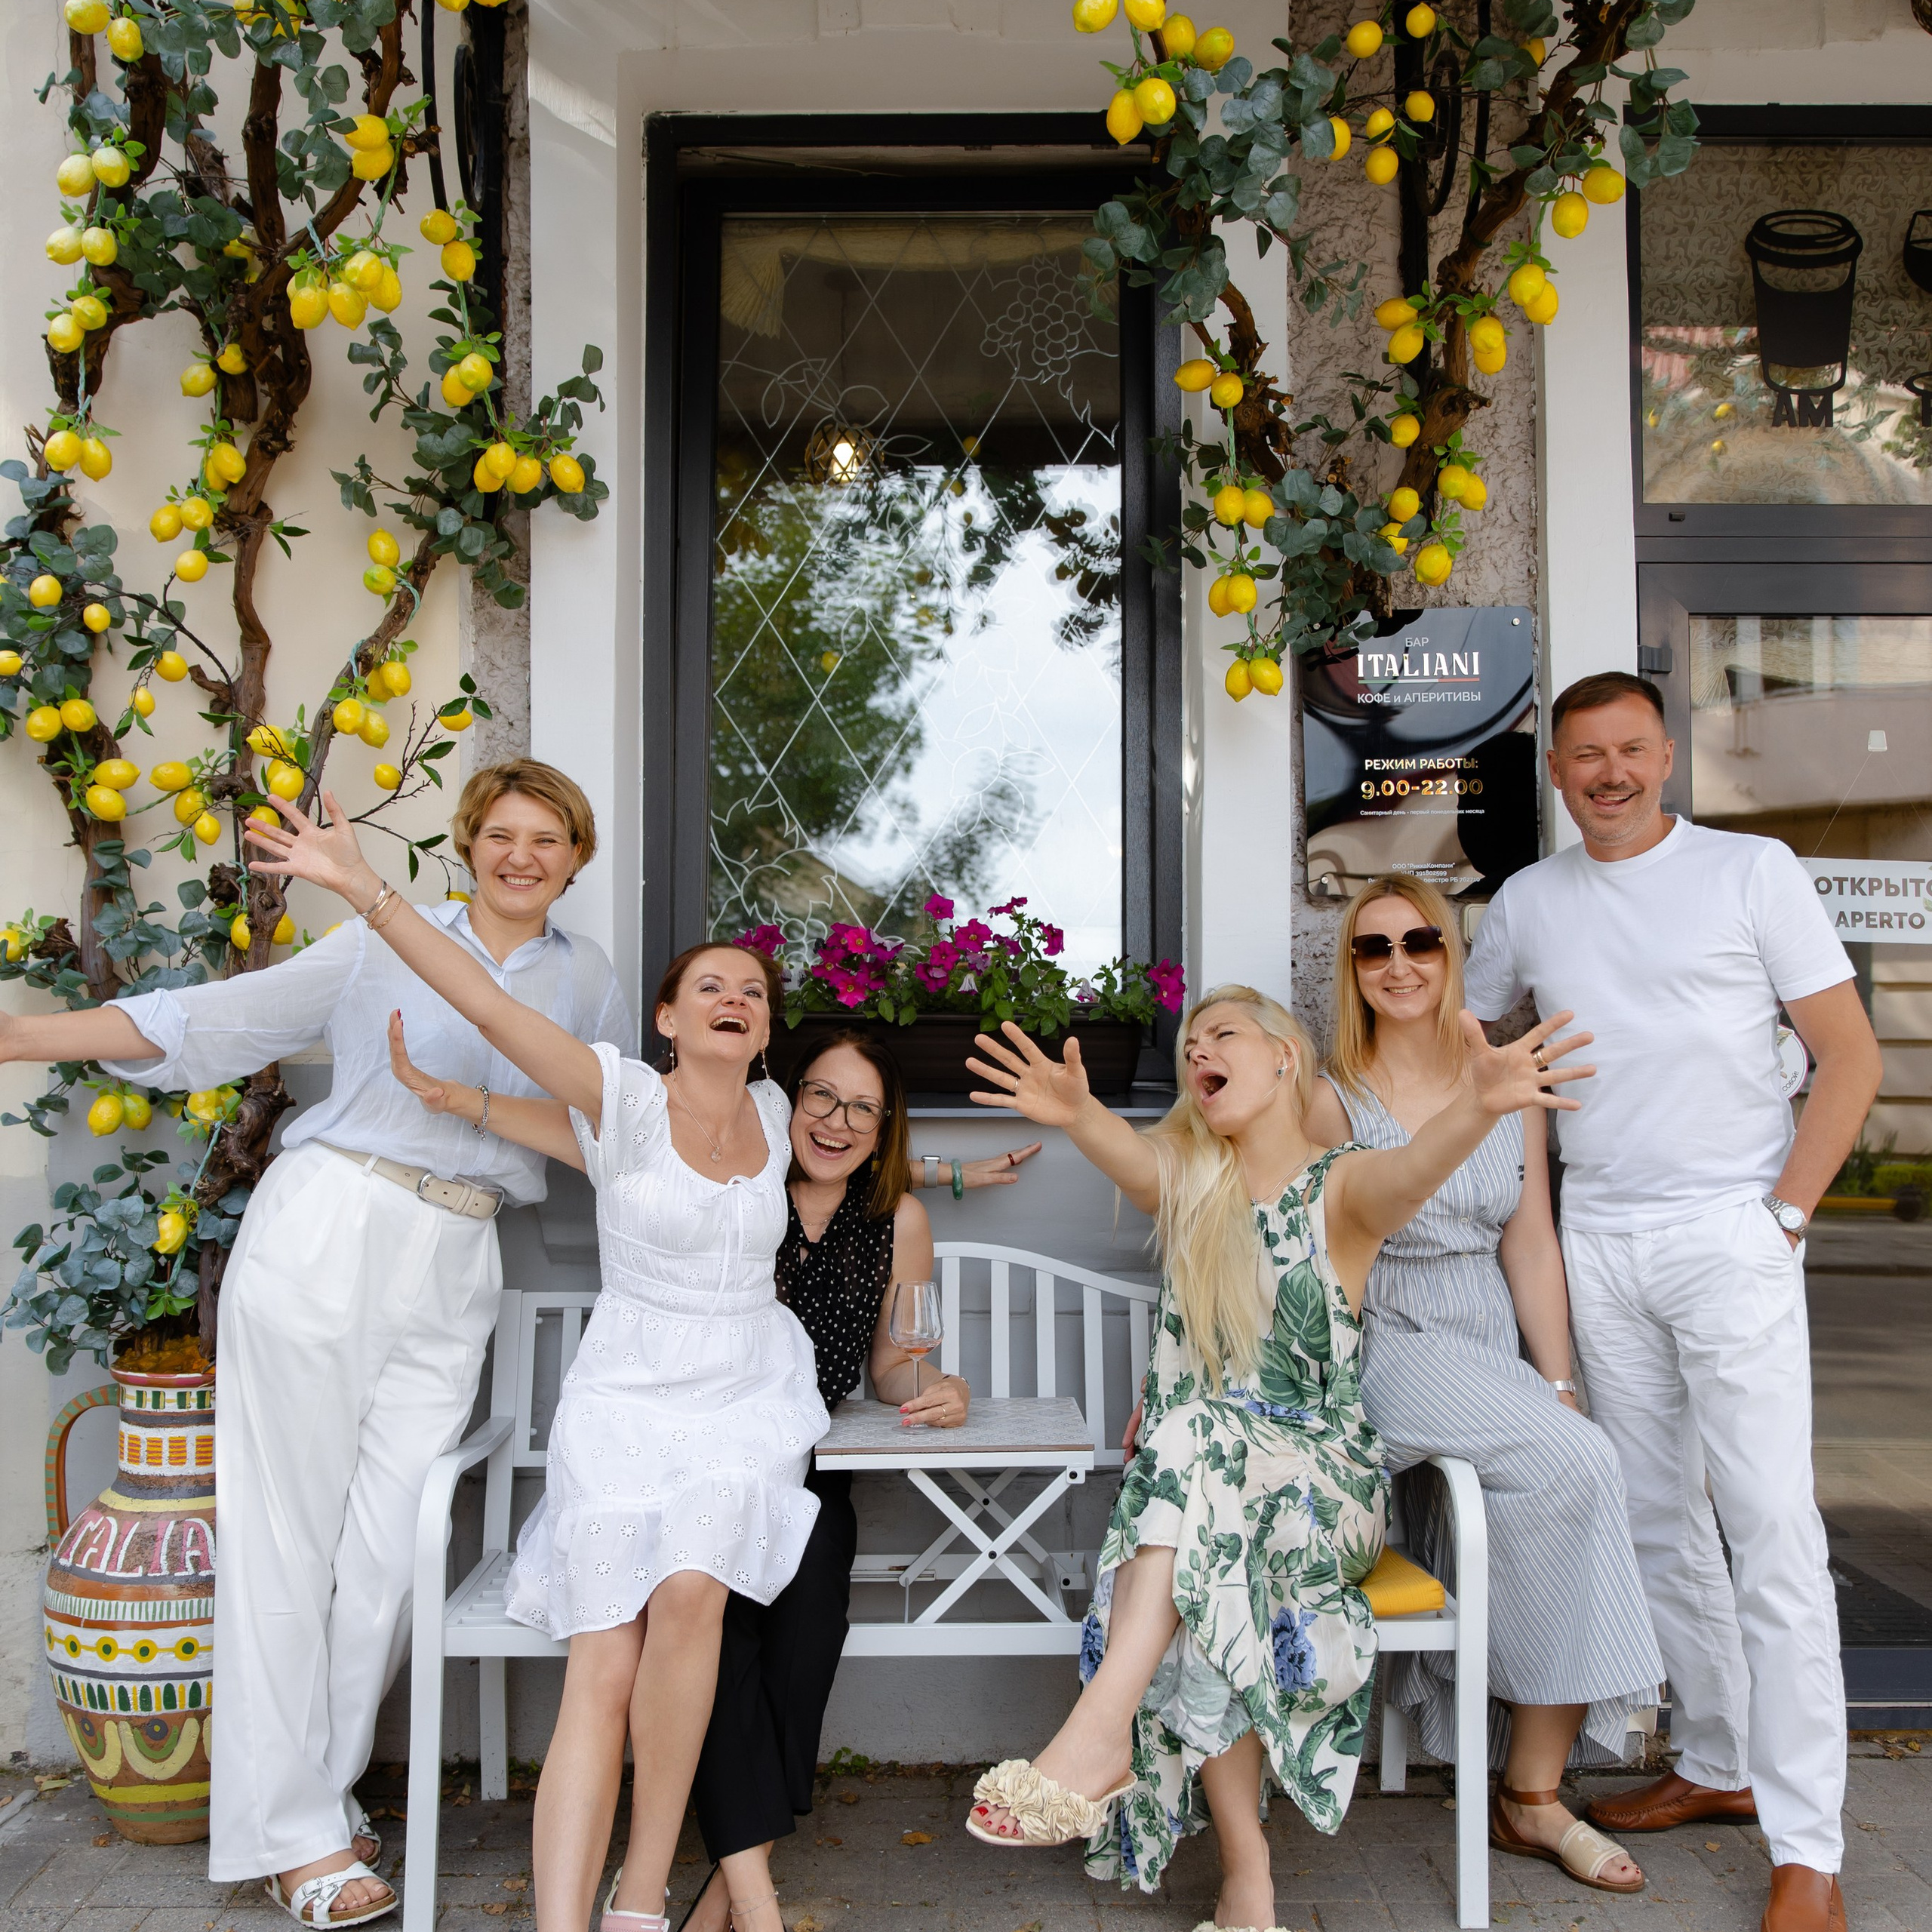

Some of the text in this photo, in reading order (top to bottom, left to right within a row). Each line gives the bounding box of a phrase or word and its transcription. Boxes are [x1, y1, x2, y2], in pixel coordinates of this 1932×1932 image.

[1771, 392, 1834, 427] AM
[1405, 637, 1429, 648] БАР
[1357, 651, 1480, 678] ITALIANI
[1357, 693, 1391, 703] КОФЕ
[1404, 691, 1481, 703] АПЕРИТИВЫ
[1364, 758, 1478, 771] РЕЖИМ РАБОТЫ:
[1361, 778, 1484, 800] 9.00-22.00
[1835, 910, 1925, 930] APERTO
